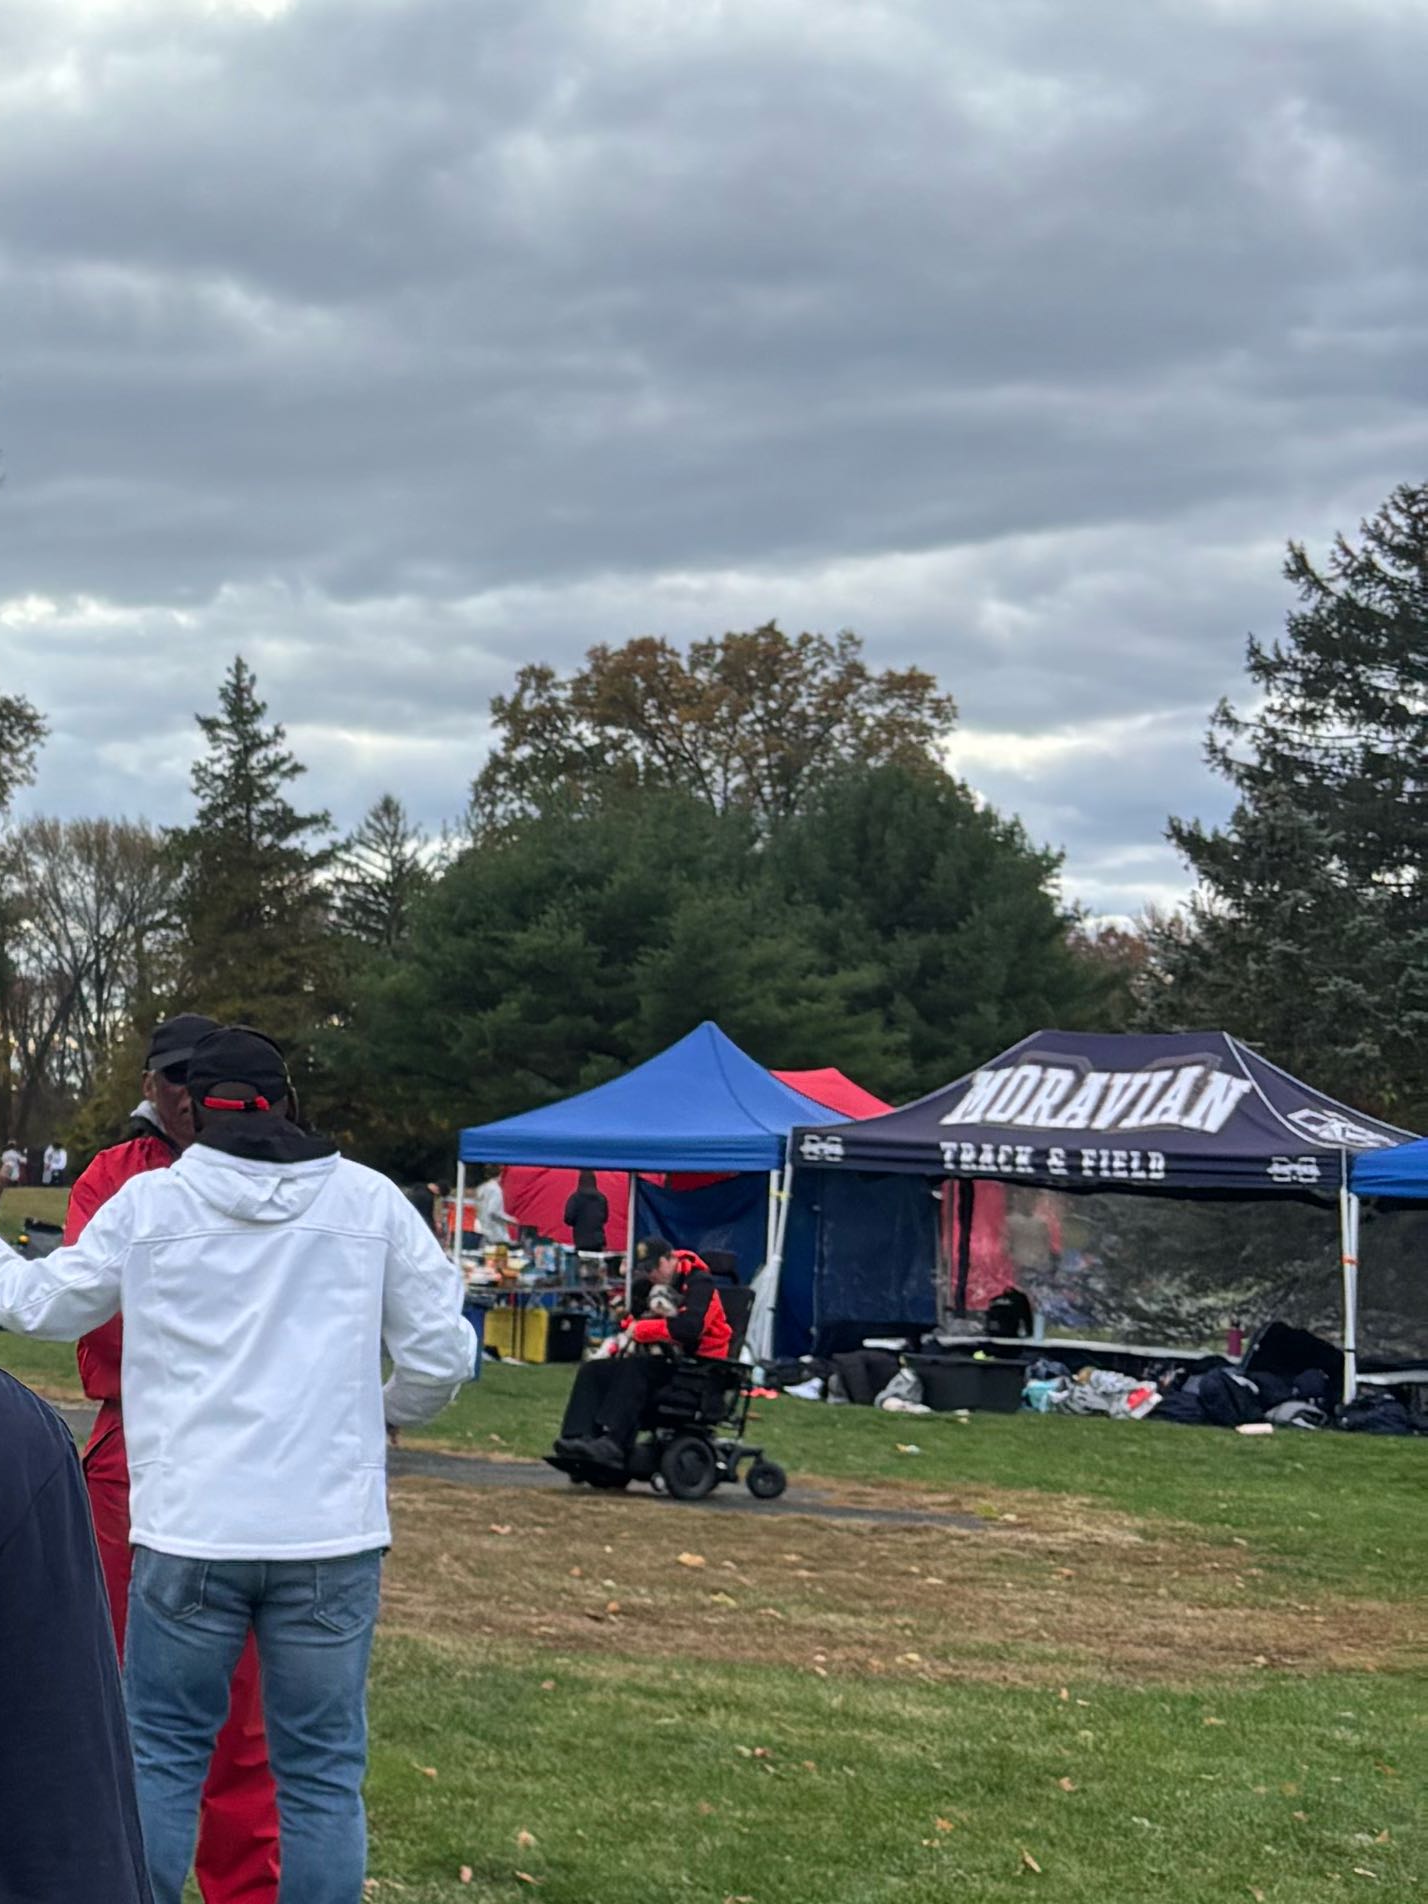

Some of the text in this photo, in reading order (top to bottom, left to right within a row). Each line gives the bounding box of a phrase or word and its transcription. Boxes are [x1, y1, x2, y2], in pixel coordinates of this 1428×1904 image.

[940, 1063, 1252, 1134] MORAVIAN
[940, 1141, 1166, 1180] TRACK & FIELD
